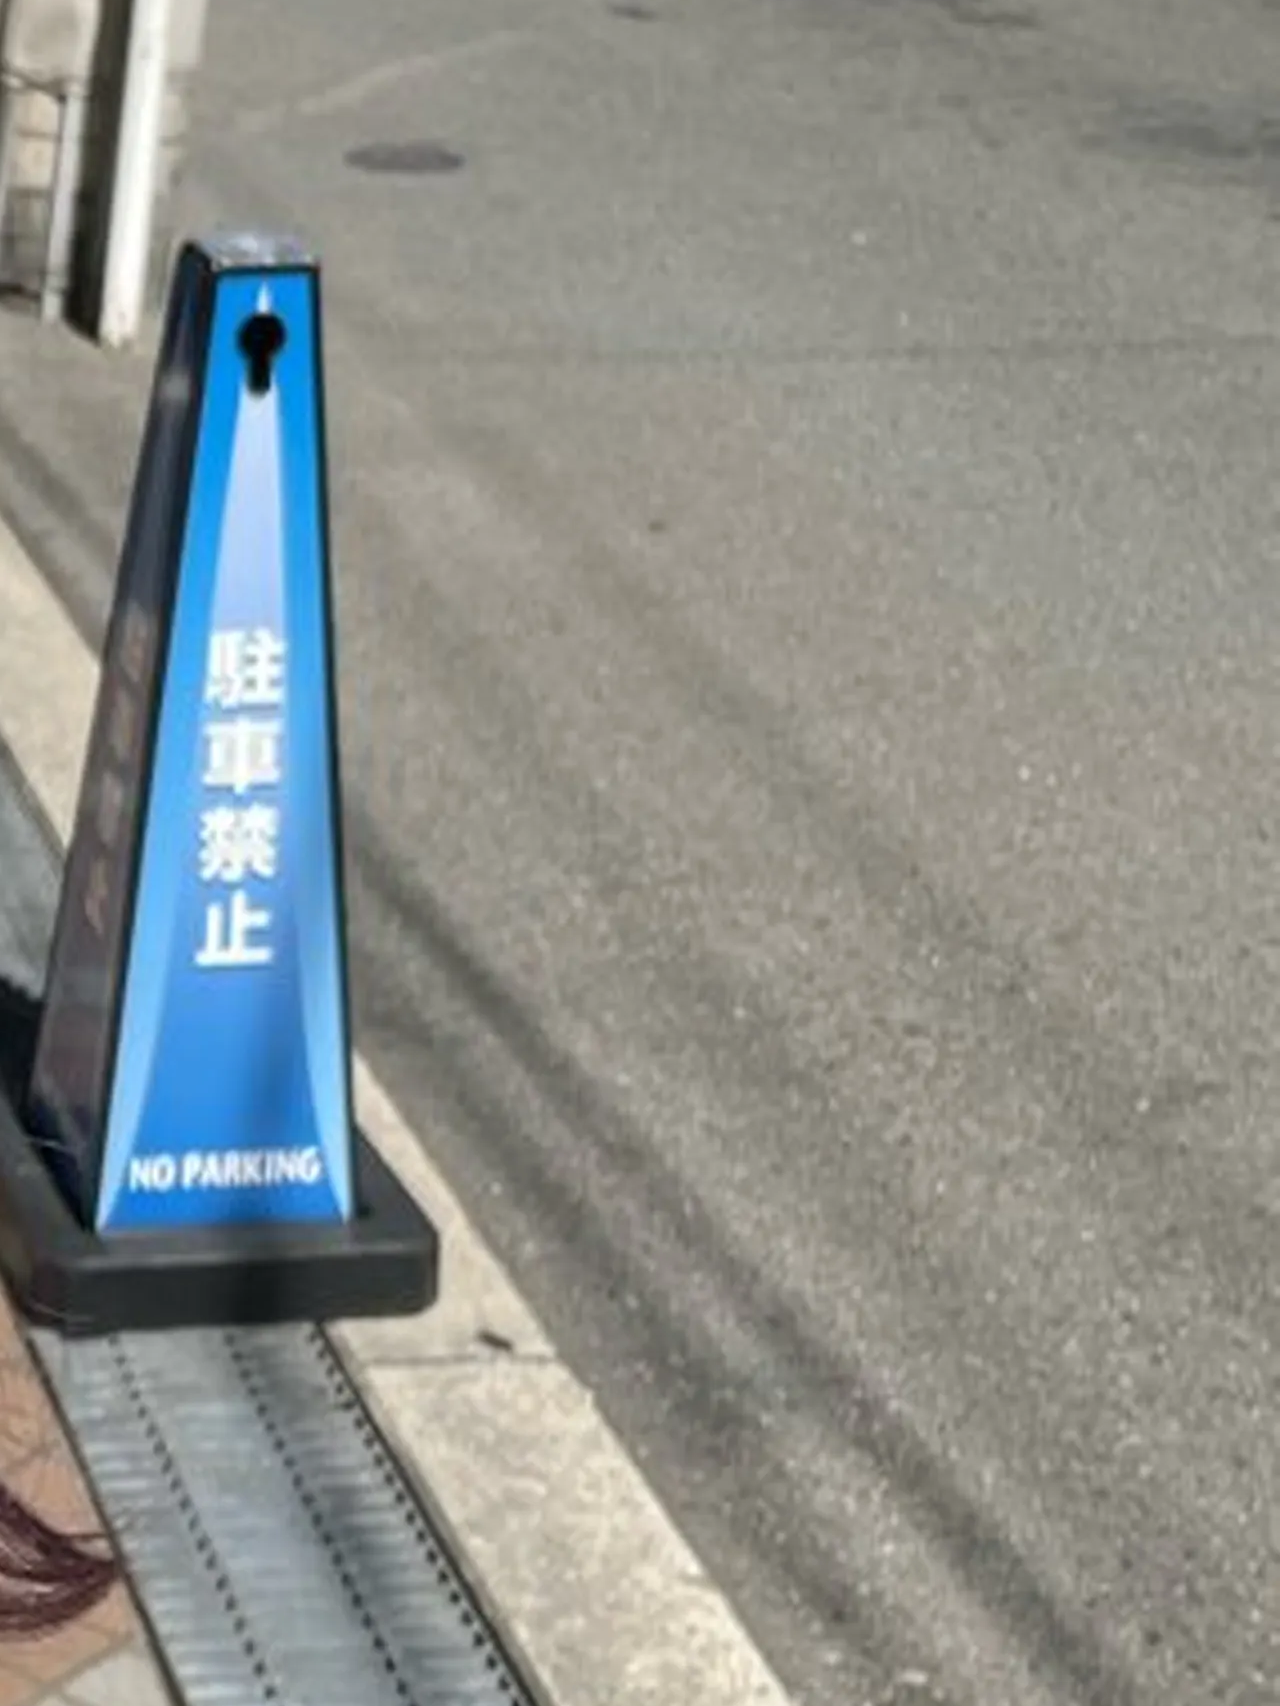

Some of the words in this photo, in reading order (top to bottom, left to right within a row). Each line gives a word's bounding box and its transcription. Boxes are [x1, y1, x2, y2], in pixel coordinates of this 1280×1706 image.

[194, 627, 285, 966] 駐車禁止
[129, 1155, 175, 1192] NO
[182, 1145, 322, 1190] PARKING
